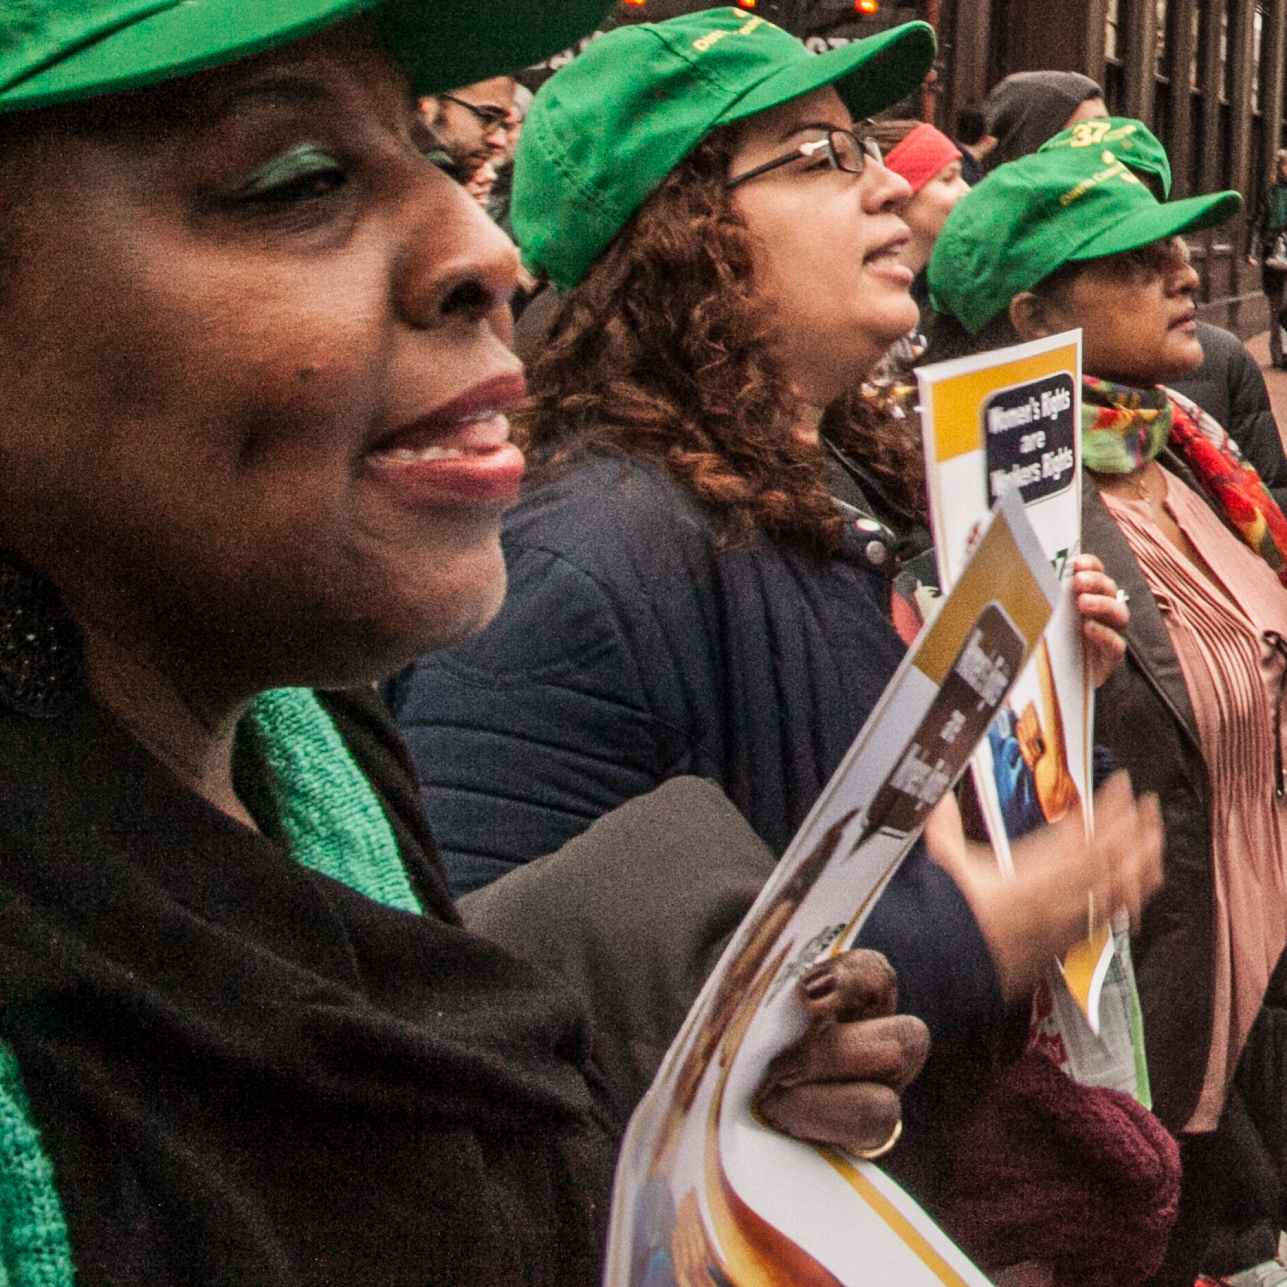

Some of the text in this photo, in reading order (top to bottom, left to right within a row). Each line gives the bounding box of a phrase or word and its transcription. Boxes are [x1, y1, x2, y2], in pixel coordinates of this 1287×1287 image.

[1070, 121, 1112, 148] 37
[987, 387, 1071, 433] Women's Rights
[1020, 431, 1046, 453] are
[1042, 446, 1073, 480] Rights
